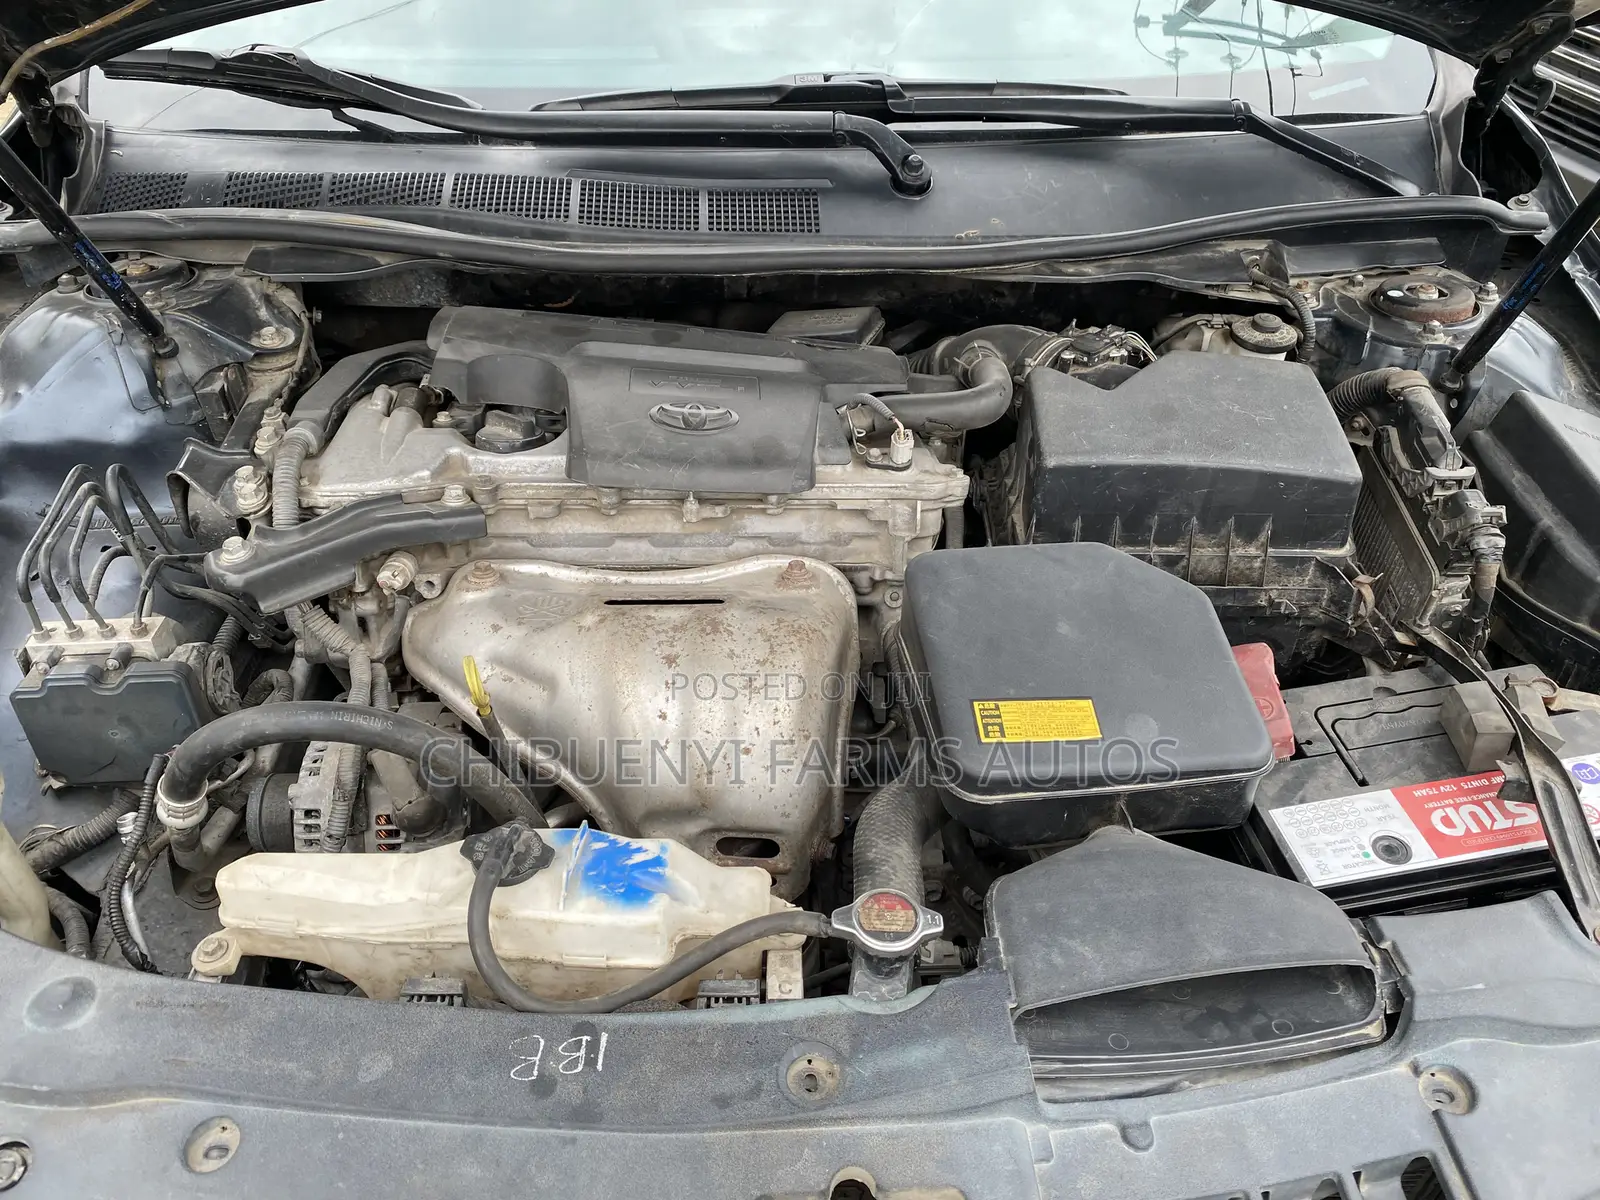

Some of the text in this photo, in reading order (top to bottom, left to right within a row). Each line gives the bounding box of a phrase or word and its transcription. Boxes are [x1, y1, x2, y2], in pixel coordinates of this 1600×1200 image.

[1440, 784, 1458, 793] 12V
[1460, 778, 1490, 789] DIN75
[1412, 786, 1440, 798] 75AH
[1424, 798, 1455, 809] BATTERY
[1431, 800, 1540, 837] STUD
[926, 914, 940, 925] 1.1
